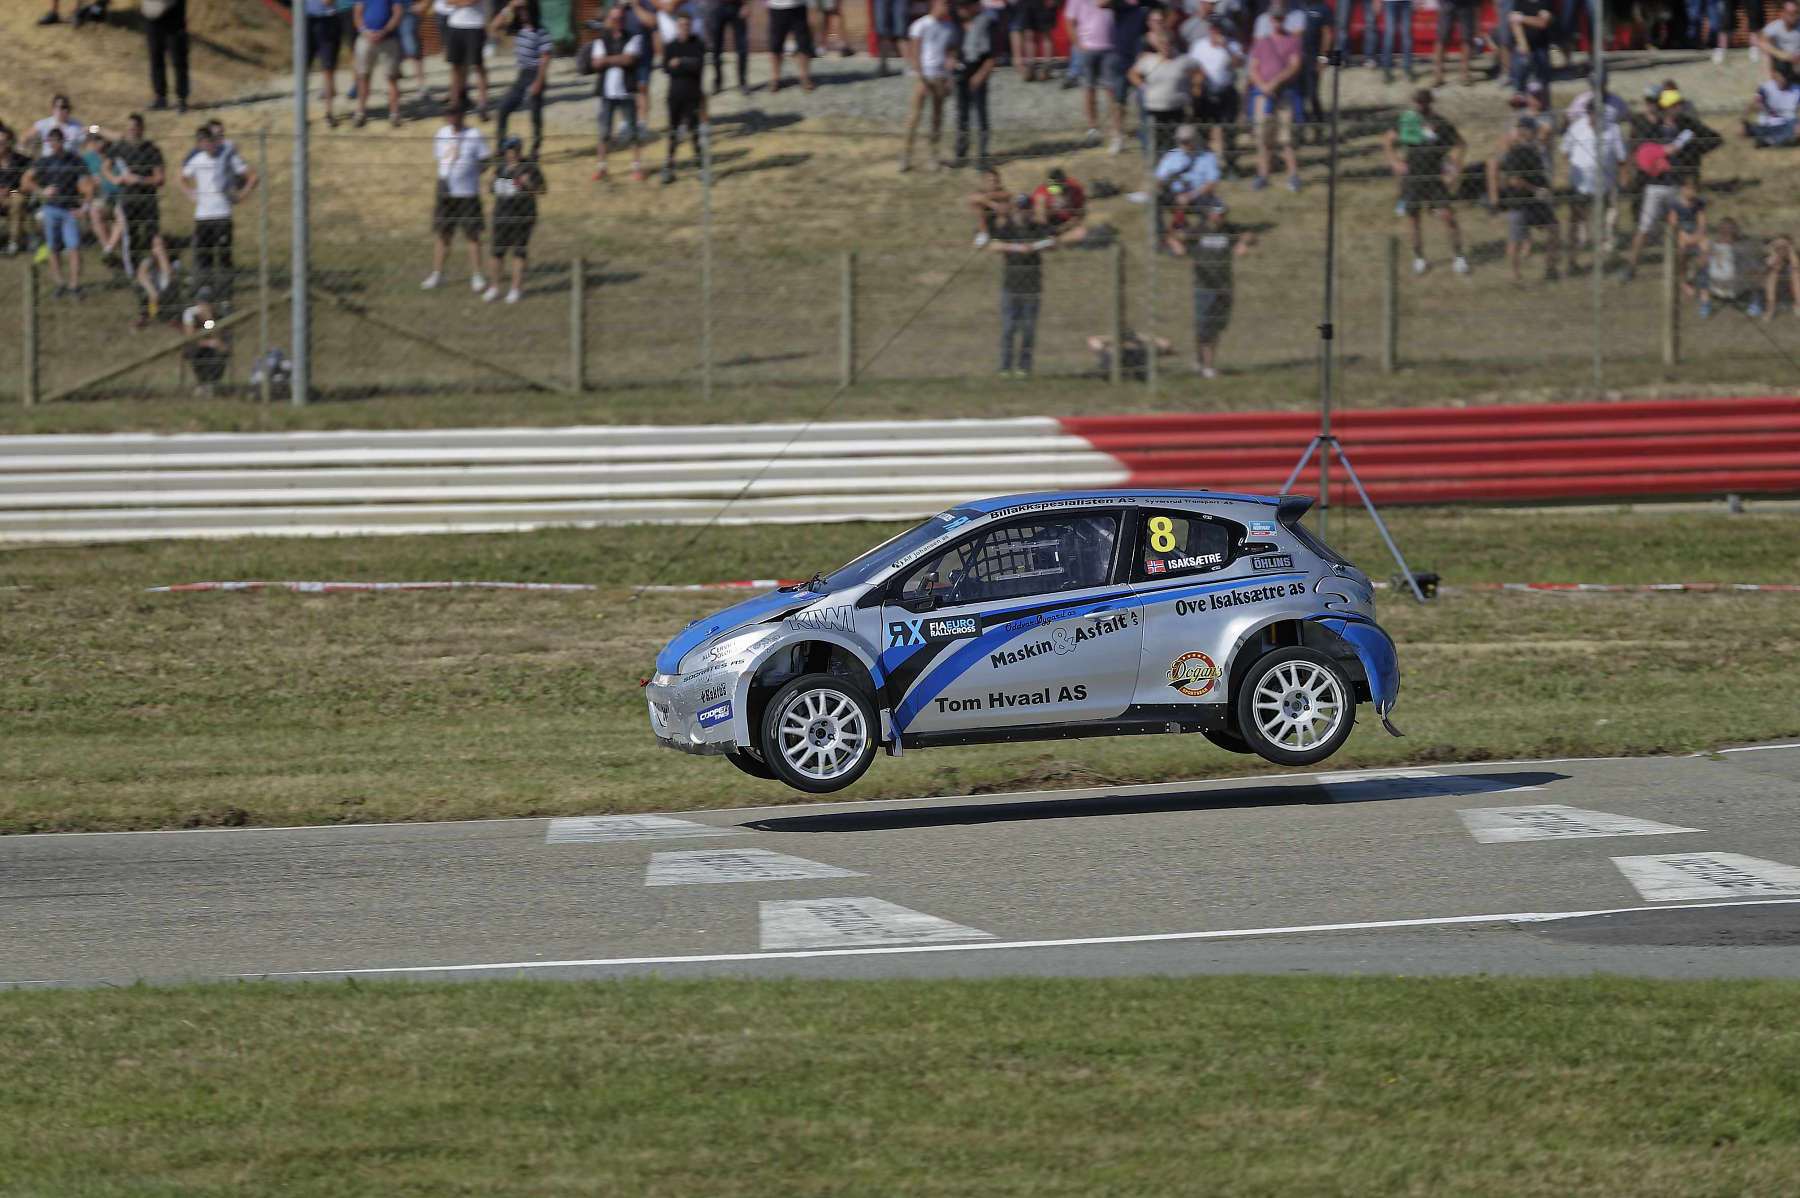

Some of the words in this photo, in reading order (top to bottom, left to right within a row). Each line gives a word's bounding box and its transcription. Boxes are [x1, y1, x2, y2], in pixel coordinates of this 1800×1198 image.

[990, 497, 1114, 519] Billakkspesialisten
[1149, 516, 1176, 553] 8
[1168, 552, 1223, 569] ISAKSÆTRE
[1253, 557, 1292, 569] ÖHLINS
[1175, 599, 1207, 616] Ove
[1209, 584, 1286, 609] Isaksætre
[1288, 582, 1306, 595] as
[789, 604, 856, 633] KIWI
[930, 626, 977, 637] RALLYCROSS
[990, 640, 1053, 669] Maskin
[1052, 627, 1077, 656] &
[1075, 614, 1128, 643] Asfalt
[935, 697, 981, 712] Tom
[988, 687, 1050, 708] Hvaal
[1058, 684, 1088, 702] AS
